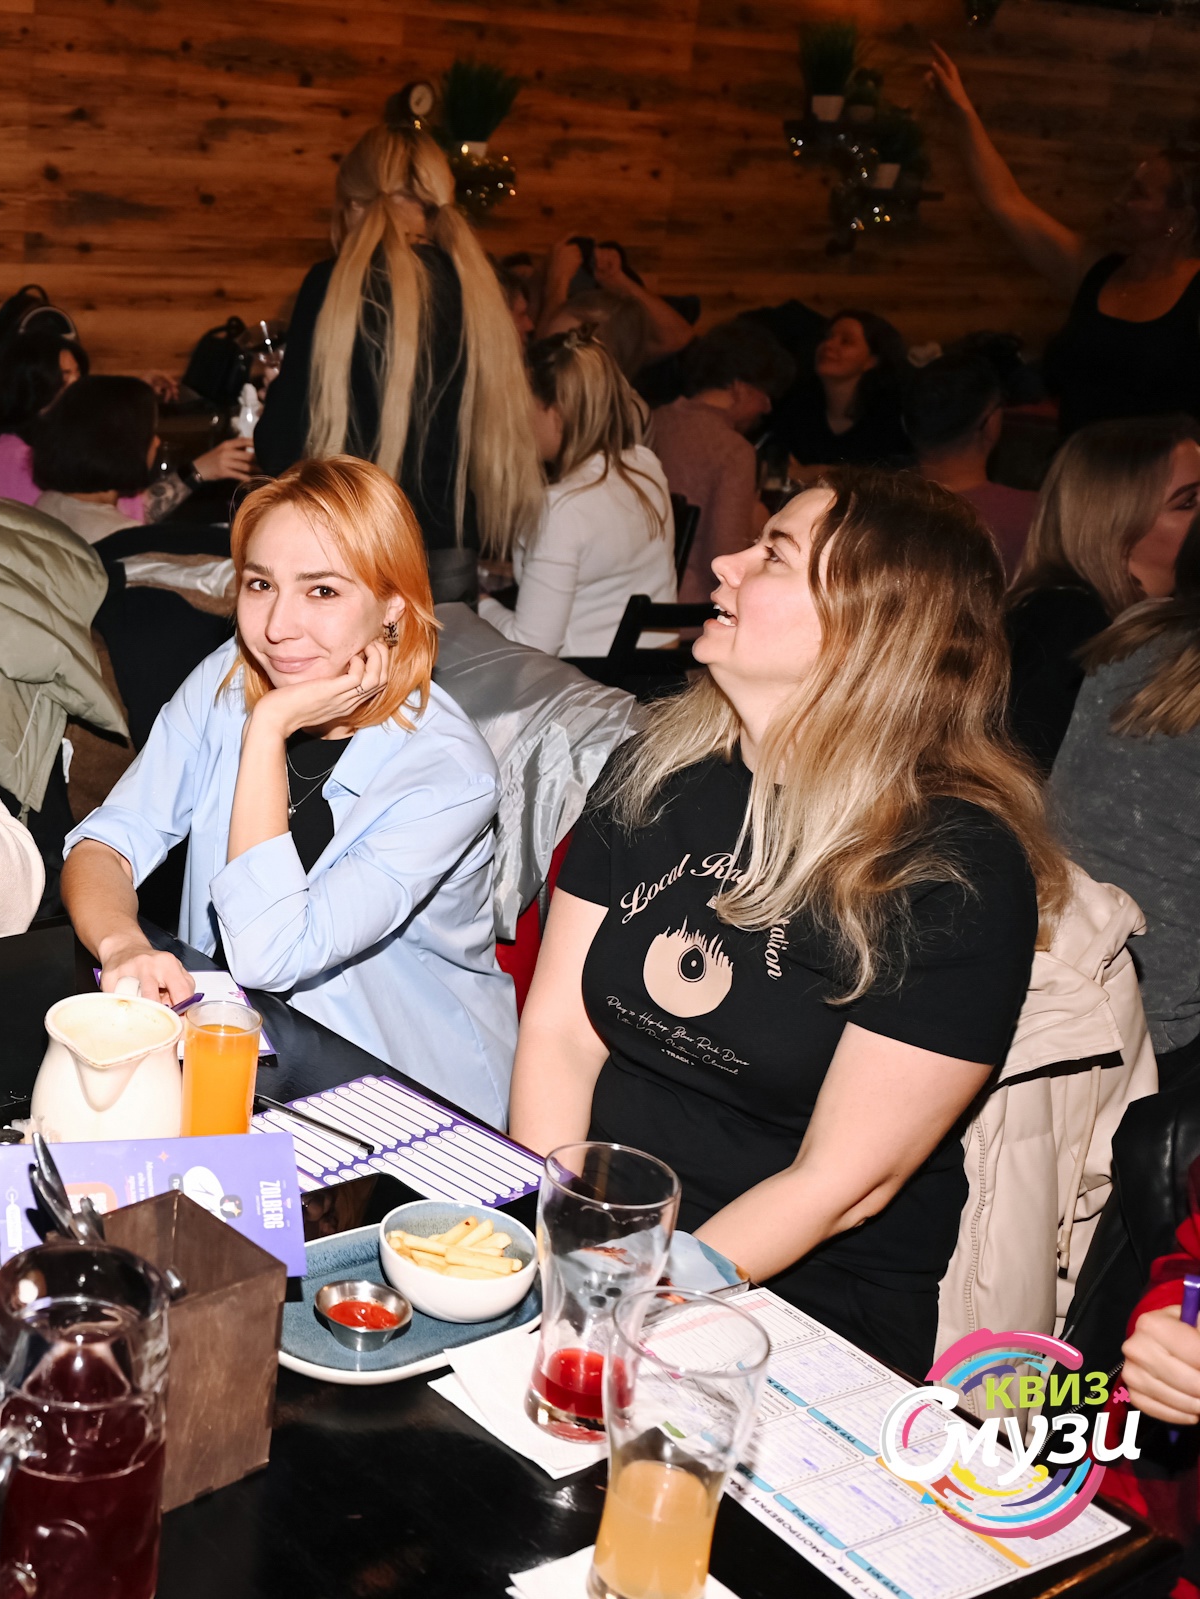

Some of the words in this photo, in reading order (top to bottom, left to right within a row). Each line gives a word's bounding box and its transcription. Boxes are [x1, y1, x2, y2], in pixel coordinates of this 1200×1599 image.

[620, 853, 691, 925] Local
[666, 1049, 690, 1065] TRACK
[259, 1180, 285, 1230] ZOLBERG
[807, 1521, 824, 1536] ТУР
[882, 1581, 901, 1595] ТУР
